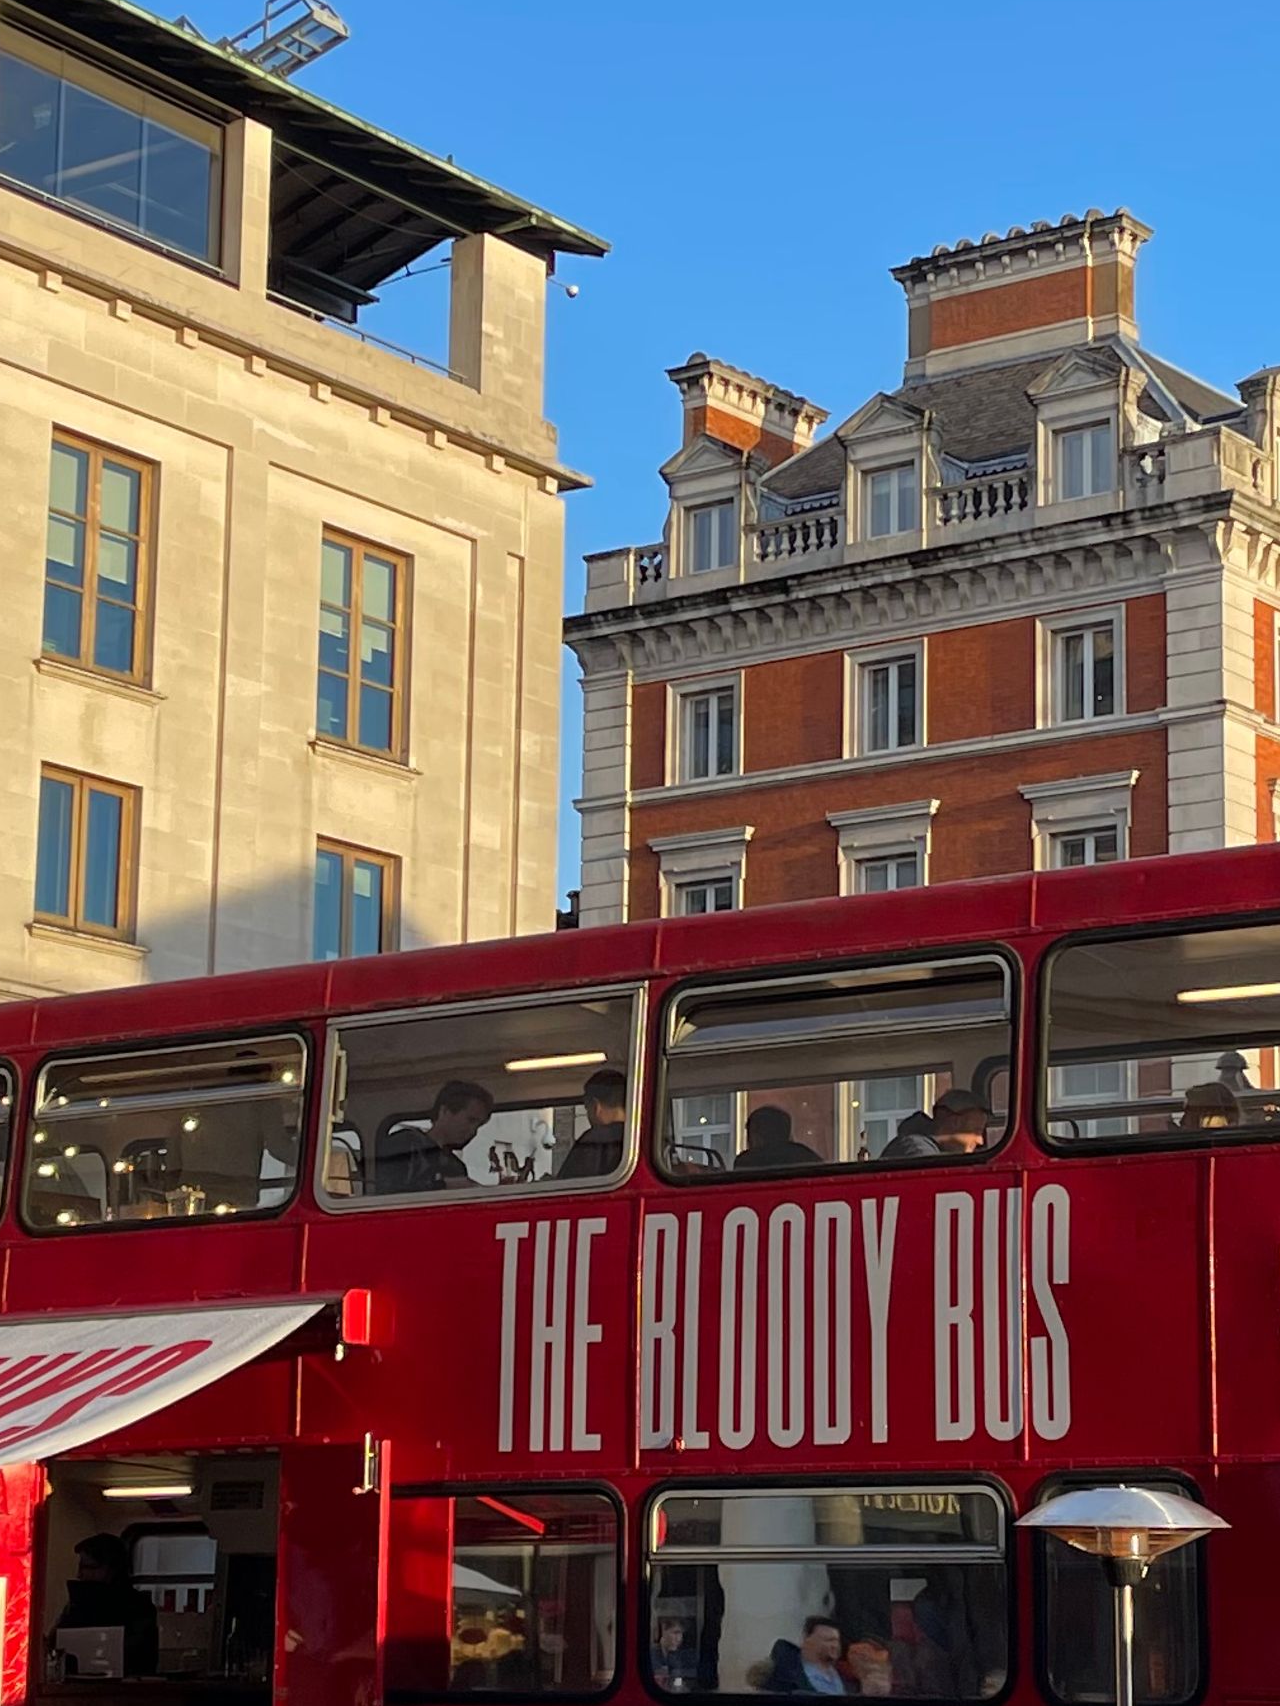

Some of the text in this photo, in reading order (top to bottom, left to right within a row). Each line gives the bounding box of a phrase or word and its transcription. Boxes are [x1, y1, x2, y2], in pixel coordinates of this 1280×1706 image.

[495, 1183, 1072, 1453] THE BLOODY BUS
